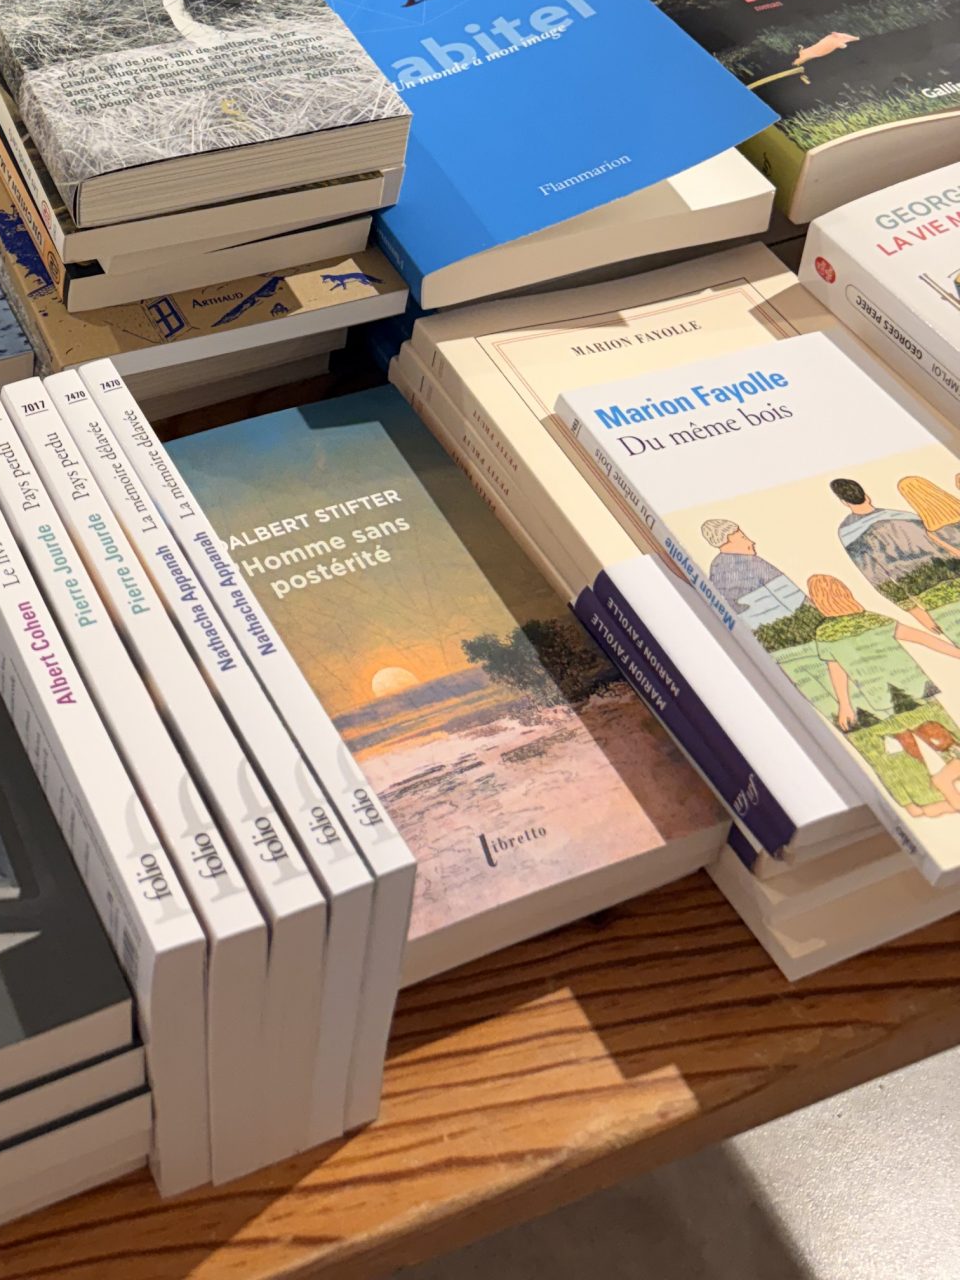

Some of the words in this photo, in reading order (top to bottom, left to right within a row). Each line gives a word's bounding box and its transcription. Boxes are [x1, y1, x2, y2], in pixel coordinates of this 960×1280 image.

[538, 153, 632, 197] Flammarion
[65, 390, 86, 402] 7470
[594, 394, 696, 430] Marion
[691, 370, 789, 404] Fayolle
[617, 434, 666, 456] Du
[669, 419, 741, 445] même
[737, 401, 793, 427] bois
[315, 489, 402, 524] STIFTER
[352, 517, 410, 544] sans
[270, 544, 392, 599] postérité
[18, 601, 51, 652] Cohen
[40, 652, 77, 705] Albert
